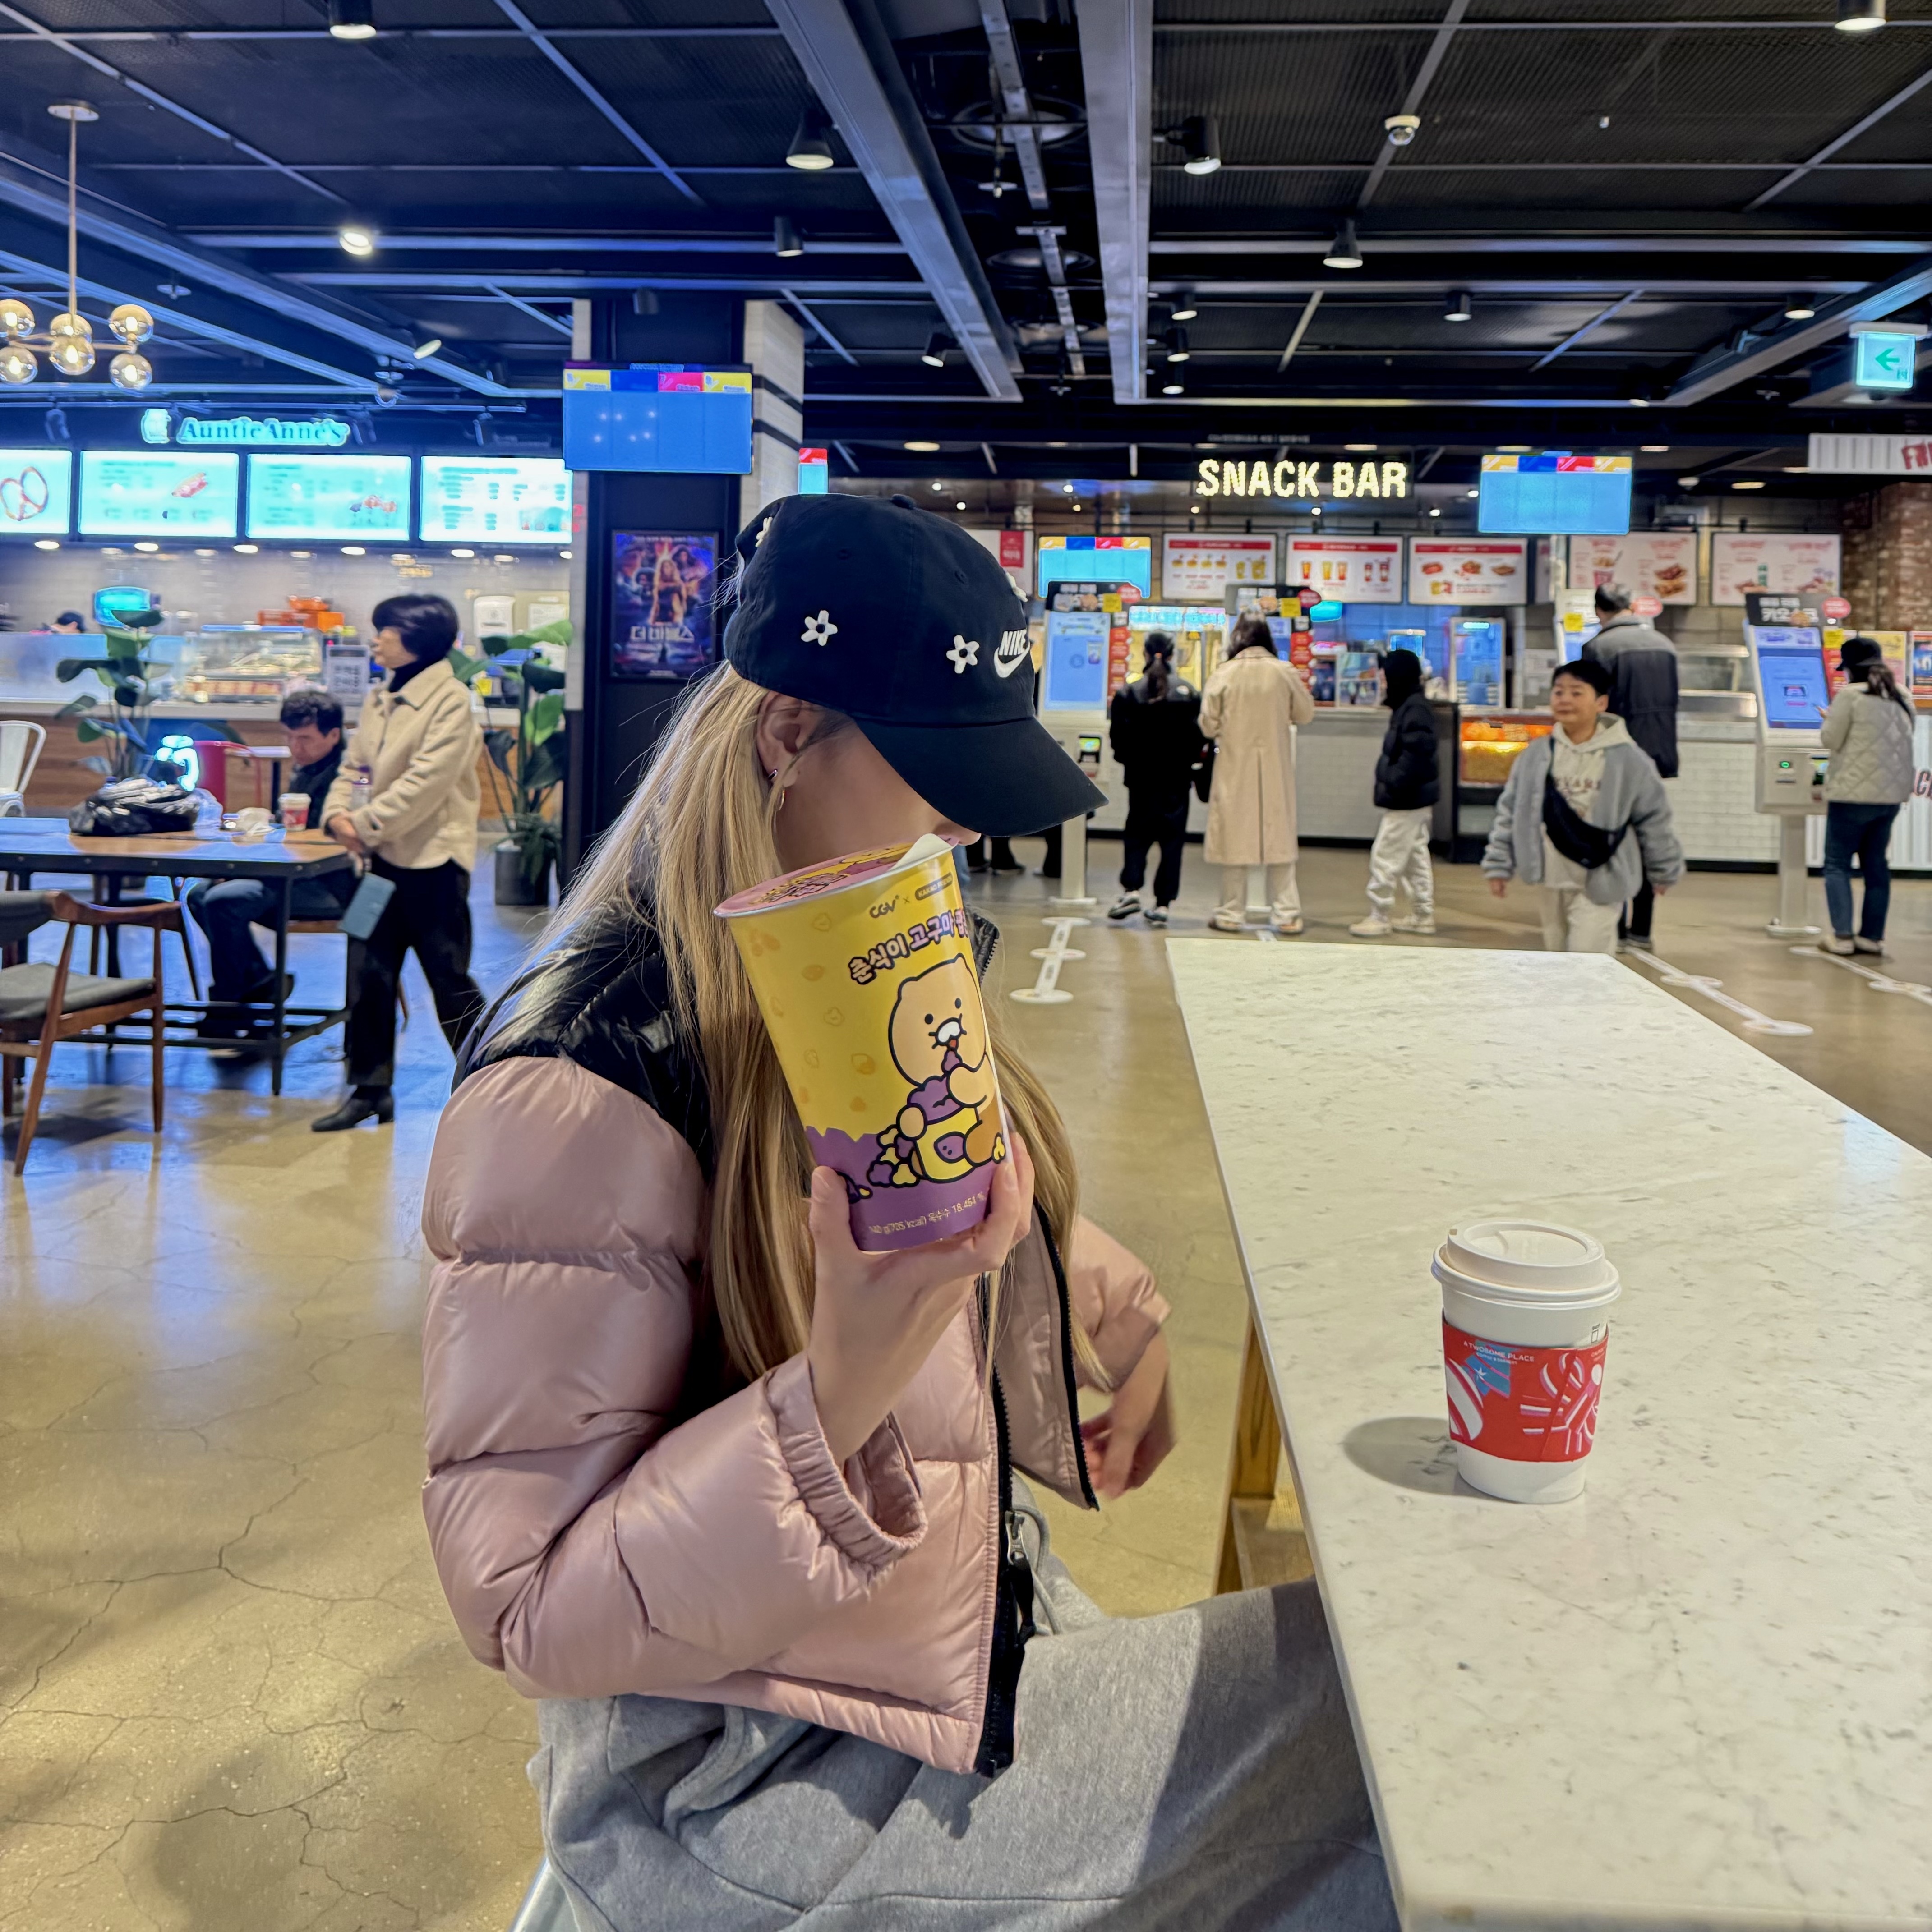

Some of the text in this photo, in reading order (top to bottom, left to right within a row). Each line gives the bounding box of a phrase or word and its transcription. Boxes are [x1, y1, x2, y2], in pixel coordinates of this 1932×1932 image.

[1196, 459, 1406, 497] SNACK BAR
[998, 629, 1027, 656] NIKE
[869, 899, 896, 918] CGV
[848, 932, 910, 985] 춘식이
[908, 910, 954, 952] 고구마
[1508, 1352, 1535, 1362] PLACE
